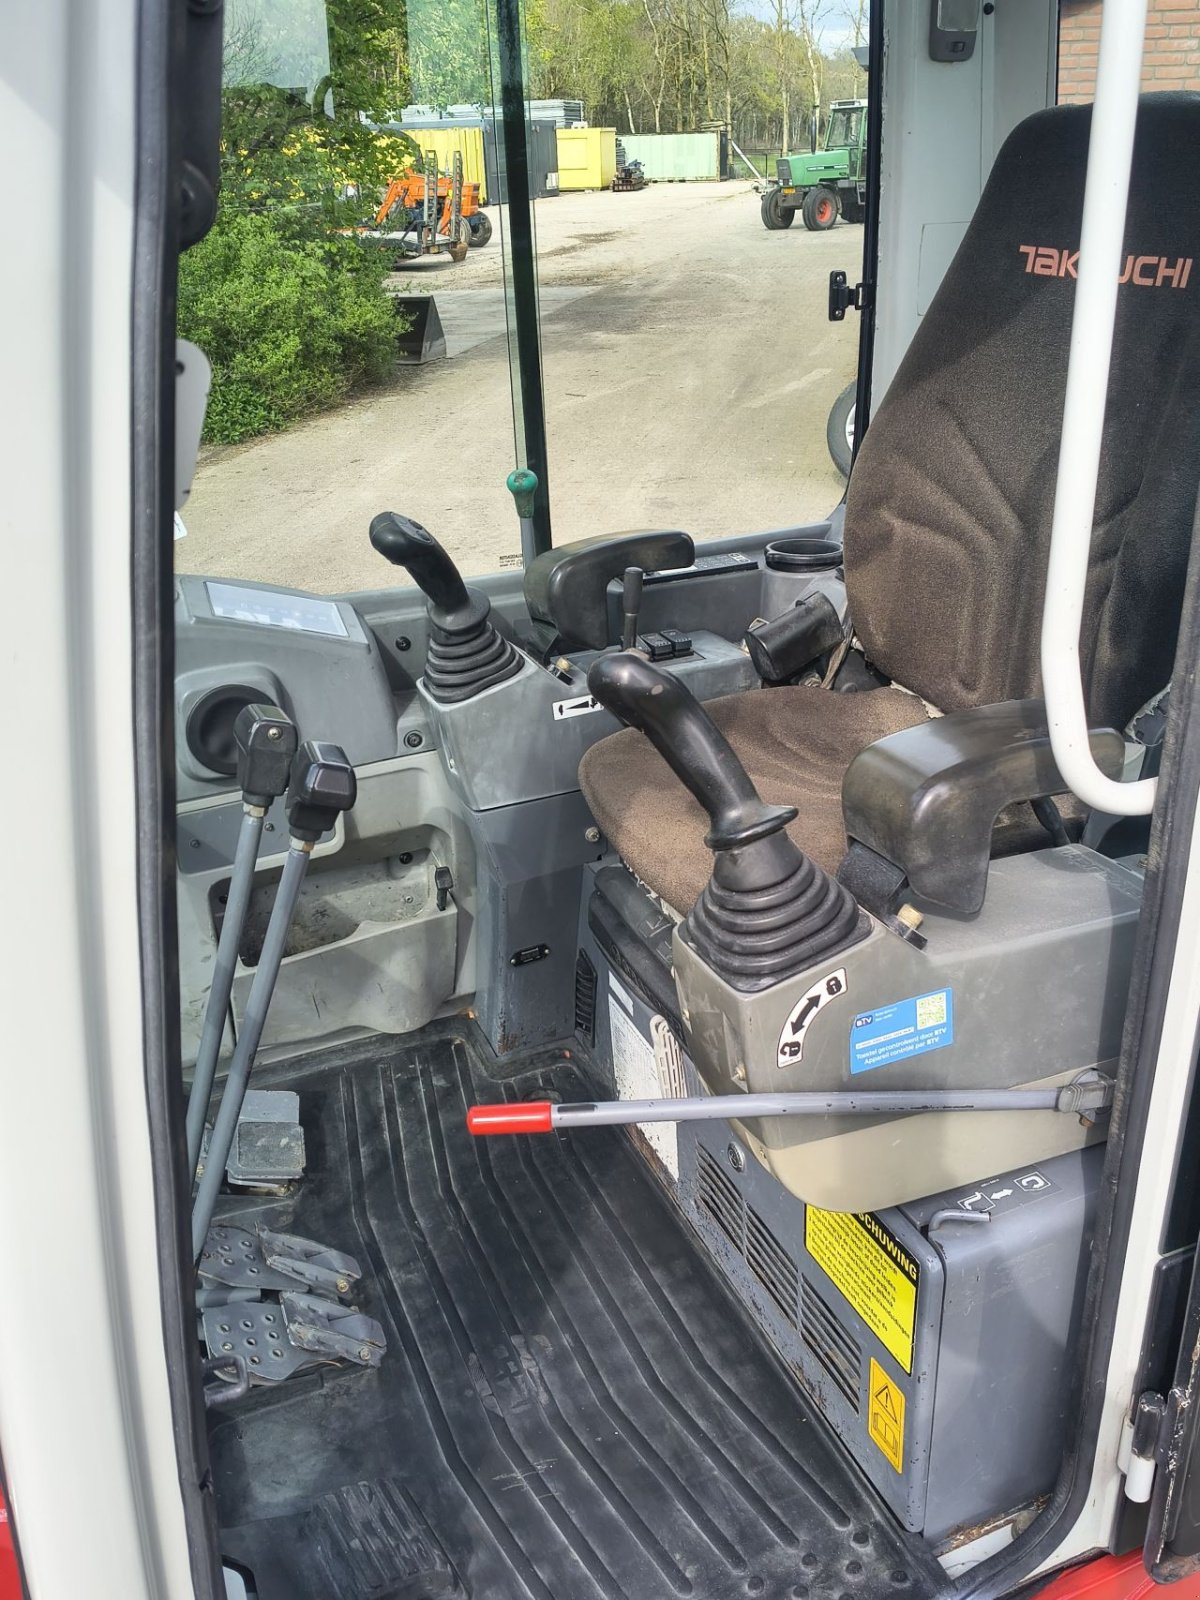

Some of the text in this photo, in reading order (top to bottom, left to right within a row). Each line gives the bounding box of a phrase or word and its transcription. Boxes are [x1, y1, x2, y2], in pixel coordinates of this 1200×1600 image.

[1019, 245, 1193, 288] TAKUCHI
[856, 1016, 872, 1027] BTV
[856, 1049, 878, 1060] Toestel
[878, 1036, 919, 1054] gecontroleerd
[920, 1033, 934, 1042] door
[934, 1027, 947, 1036] BTV
[864, 1052, 890, 1064] Appareil
[926, 1037, 939, 1046] BTV
